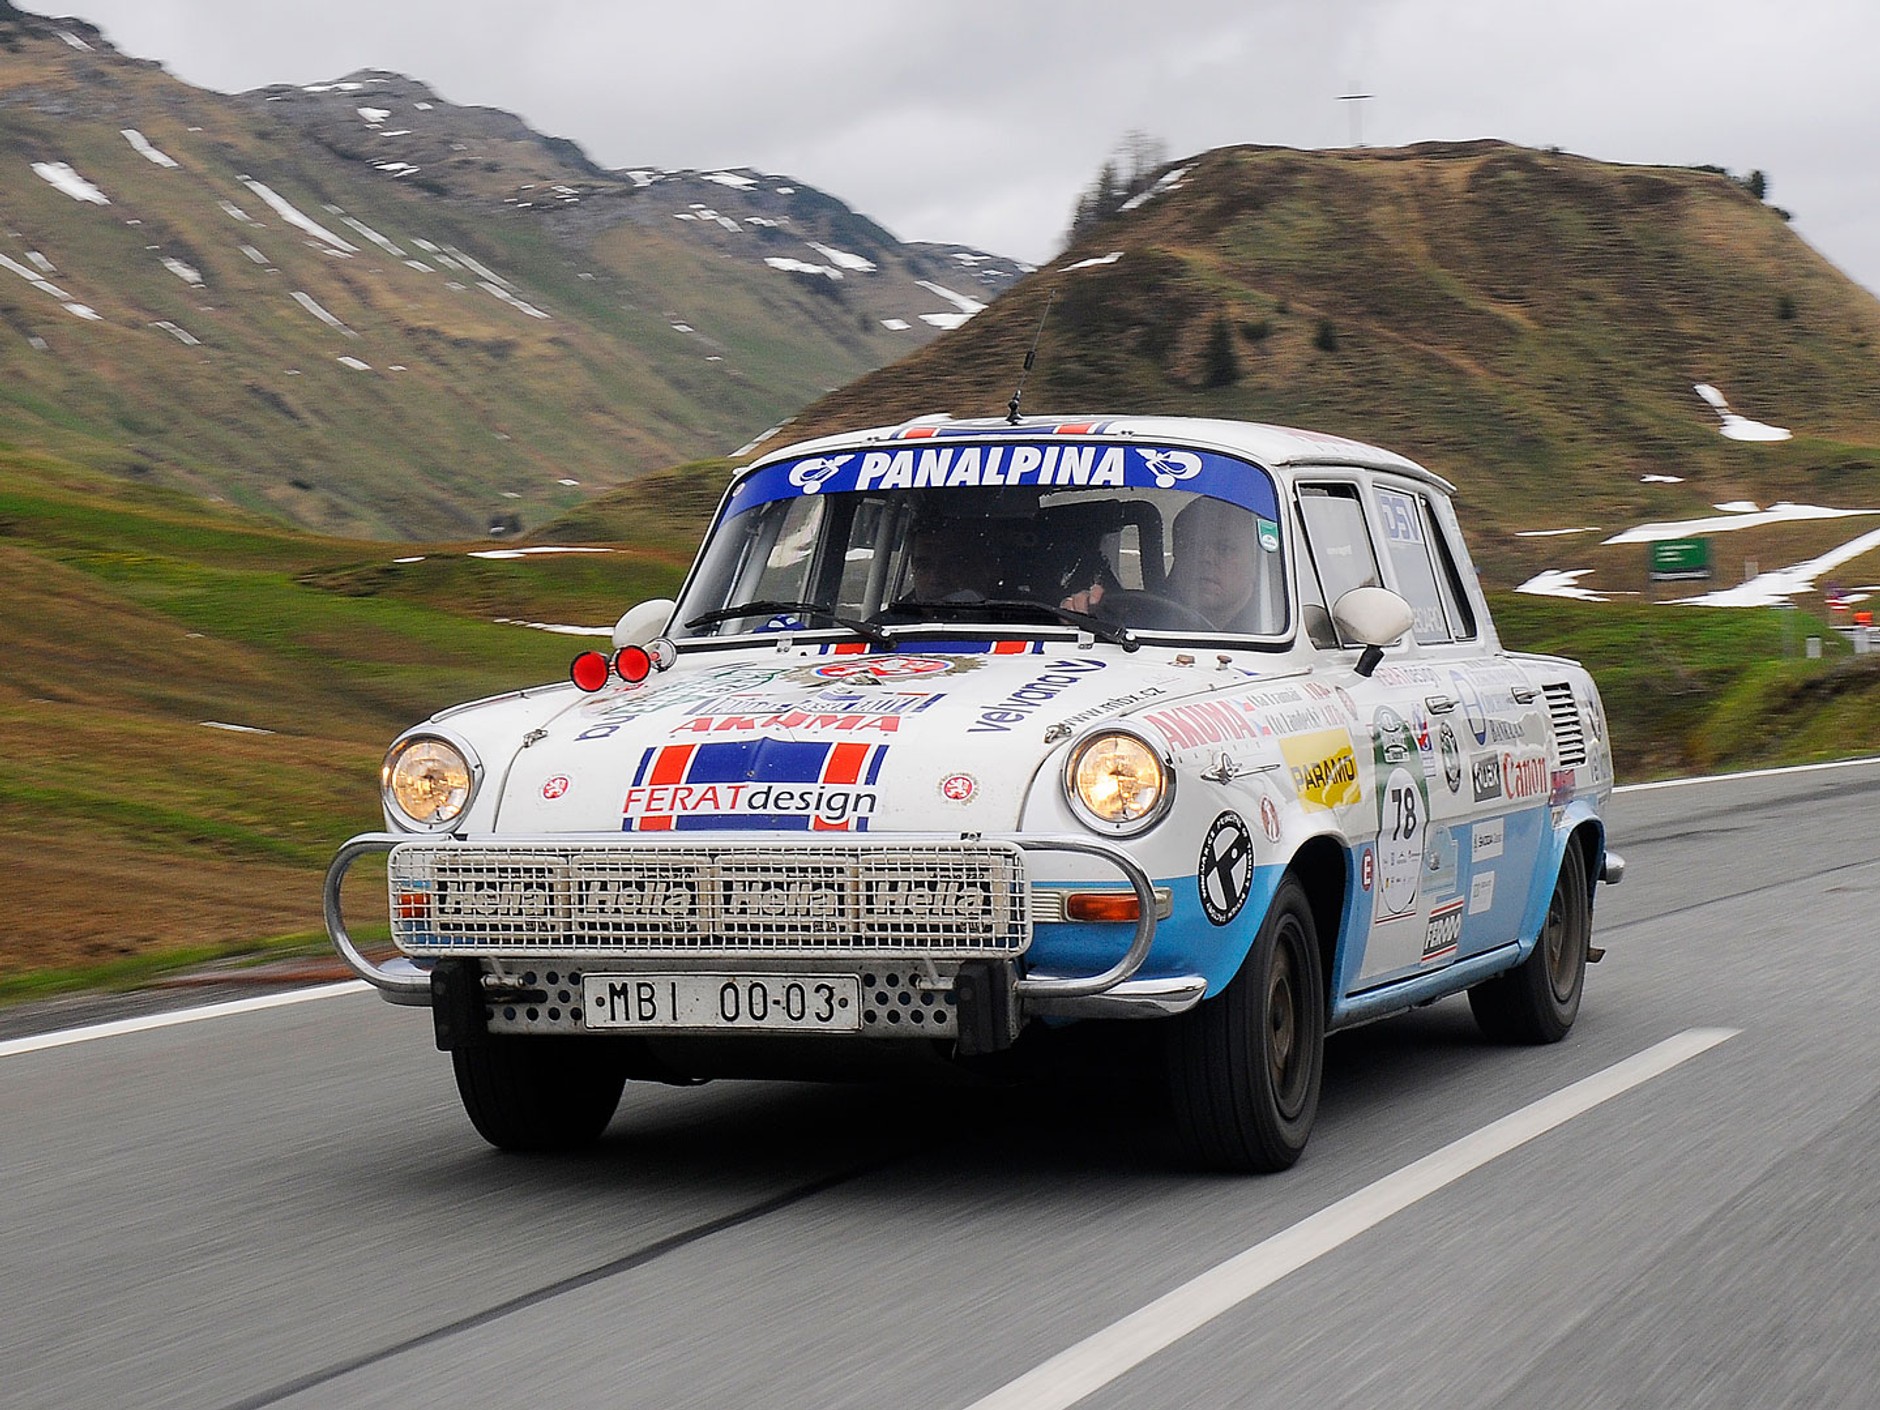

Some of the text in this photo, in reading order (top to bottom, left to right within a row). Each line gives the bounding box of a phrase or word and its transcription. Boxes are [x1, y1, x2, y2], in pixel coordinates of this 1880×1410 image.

[854, 446, 1125, 491] PANALPINA
[967, 672, 1081, 733] velvana
[671, 710, 901, 733] AKUMA
[1144, 700, 1257, 753] AKUMA
[1291, 755, 1355, 792] PARAMO
[1503, 752, 1547, 800] Canon
[622, 784, 876, 820] FERATdesign
[1392, 788, 1417, 841] 78
[445, 881, 547, 915] Hella
[587, 881, 692, 915] Hella
[729, 881, 837, 915] Hella
[876, 881, 985, 915] Hella
[608, 982, 837, 1023] MBI 00-03
